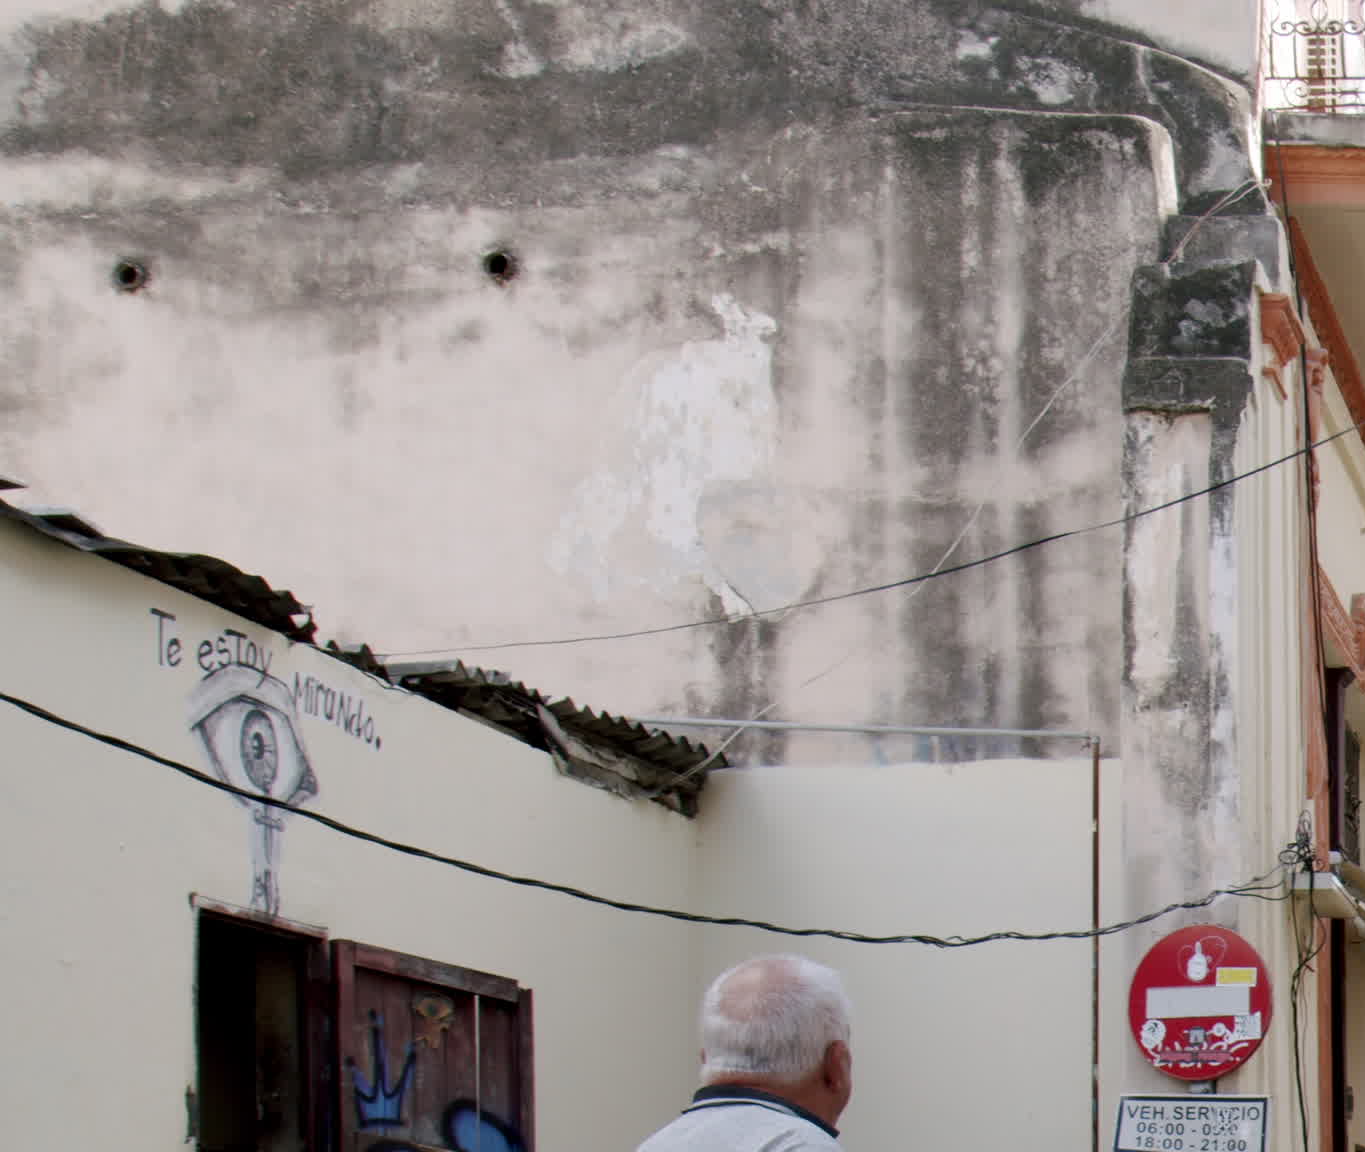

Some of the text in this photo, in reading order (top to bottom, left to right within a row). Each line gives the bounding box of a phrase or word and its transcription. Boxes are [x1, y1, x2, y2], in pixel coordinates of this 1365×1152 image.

[150, 607, 183, 667] Te
[1136, 1121, 1185, 1136] 06:00
[1135, 1136, 1184, 1151] 18:00
[1199, 1138, 1248, 1152] 21:00
